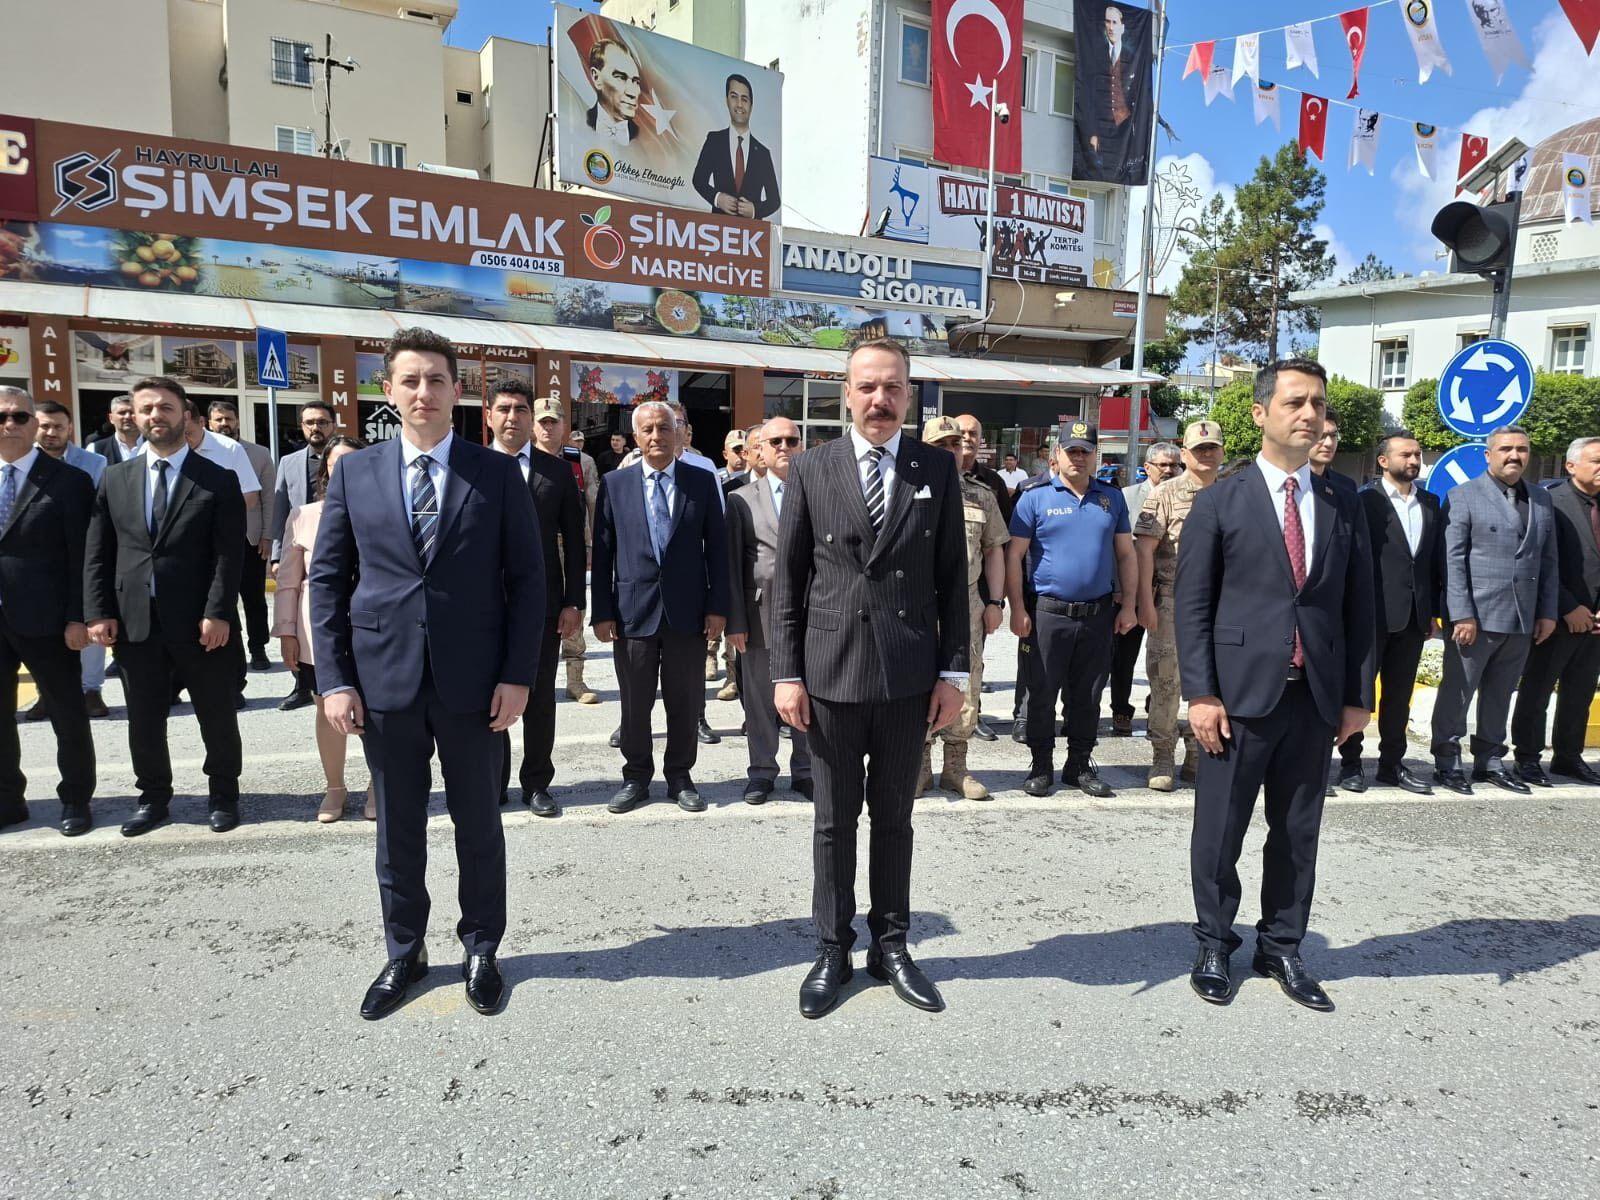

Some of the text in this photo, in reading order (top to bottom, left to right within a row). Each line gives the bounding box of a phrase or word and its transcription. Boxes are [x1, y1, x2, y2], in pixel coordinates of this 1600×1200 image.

[136, 146, 278, 178] HAYRULLAH
[121, 164, 566, 256] ŞİMŞEK EMLAK
[1010, 193, 1021, 216] 1
[630, 212, 764, 258] ŞİMŞEK
[480, 253, 507, 267] 0506
[509, 256, 530, 269] 404
[631, 256, 763, 288] NARENCİYE
[784, 246, 912, 280] ANADOLU
[42, 326, 61, 392] ALIM
[332, 369, 348, 437] EML
[365, 418, 401, 443] ŞİM
[1047, 507, 1073, 516] POLİS
